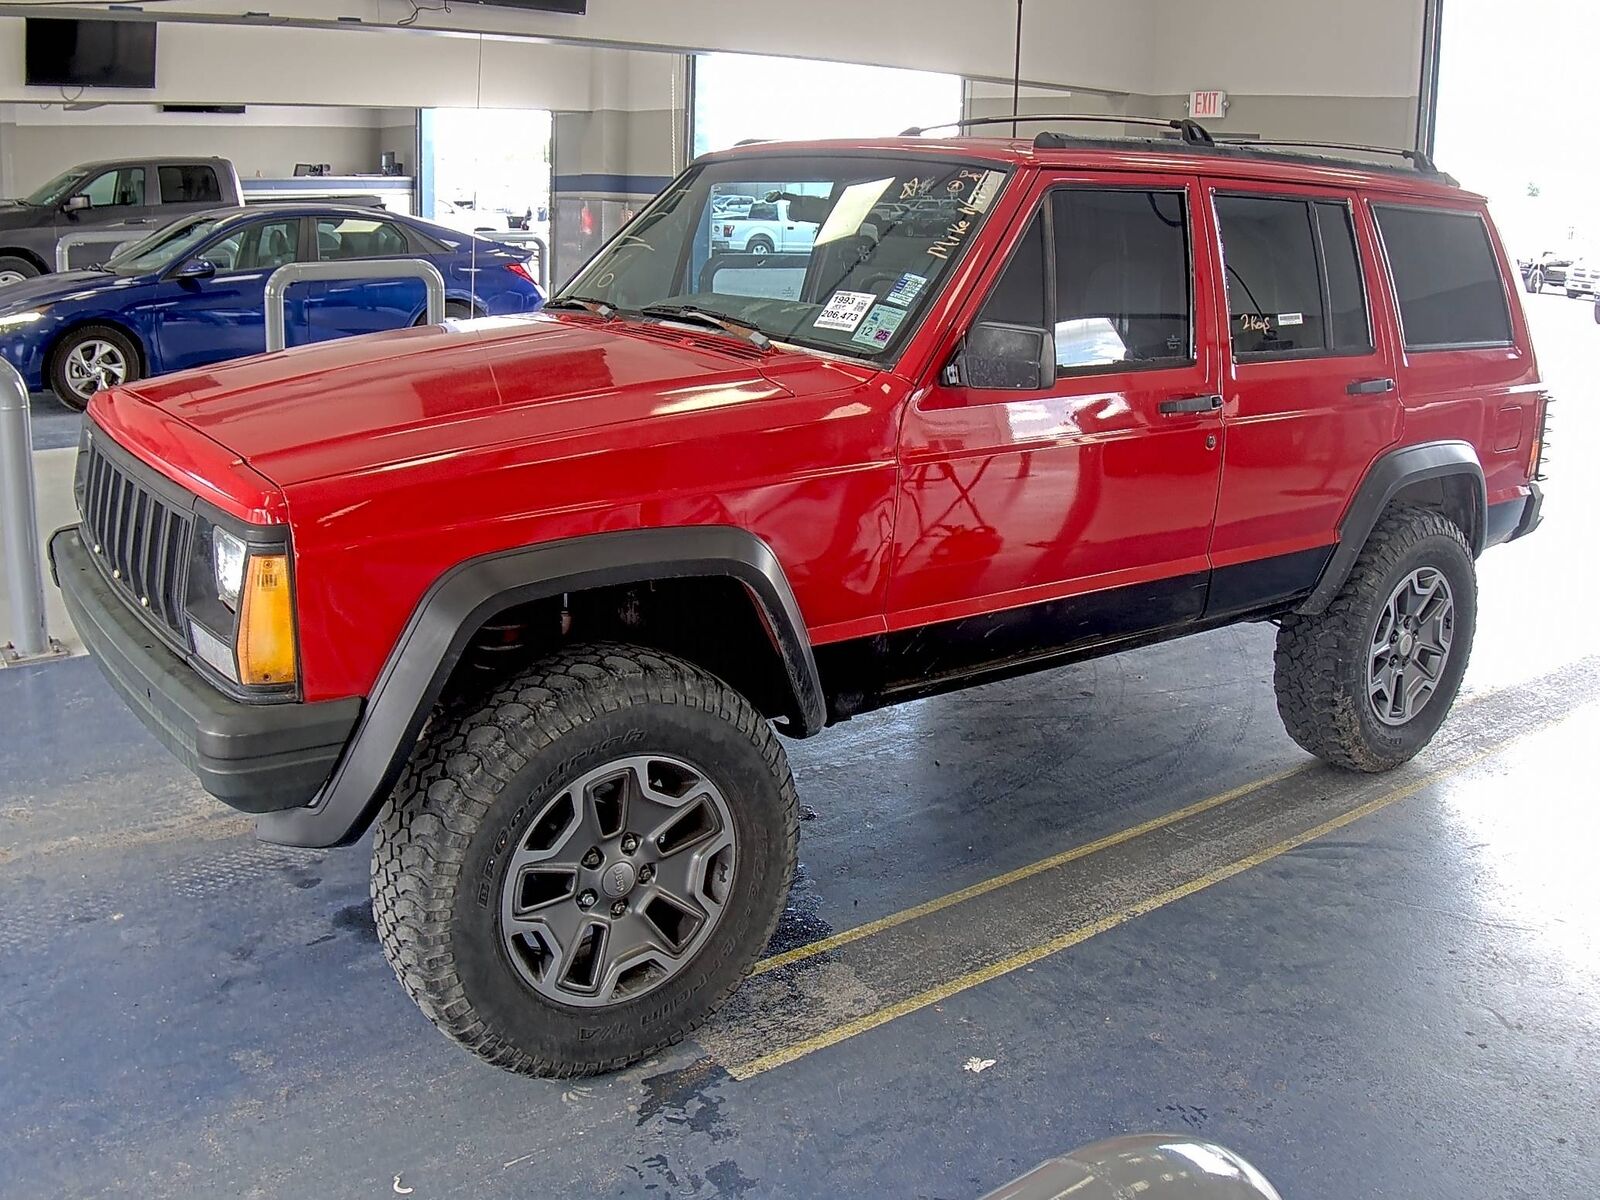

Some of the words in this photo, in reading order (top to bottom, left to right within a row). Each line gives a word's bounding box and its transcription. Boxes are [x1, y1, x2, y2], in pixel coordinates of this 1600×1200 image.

[1194, 92, 1219, 114] EXIT
[926, 219, 971, 260] Mike
[833, 295, 856, 305] 1993
[820, 309, 859, 322] 206,473
[860, 326, 873, 337] 12
[875, 329, 890, 341] 25
